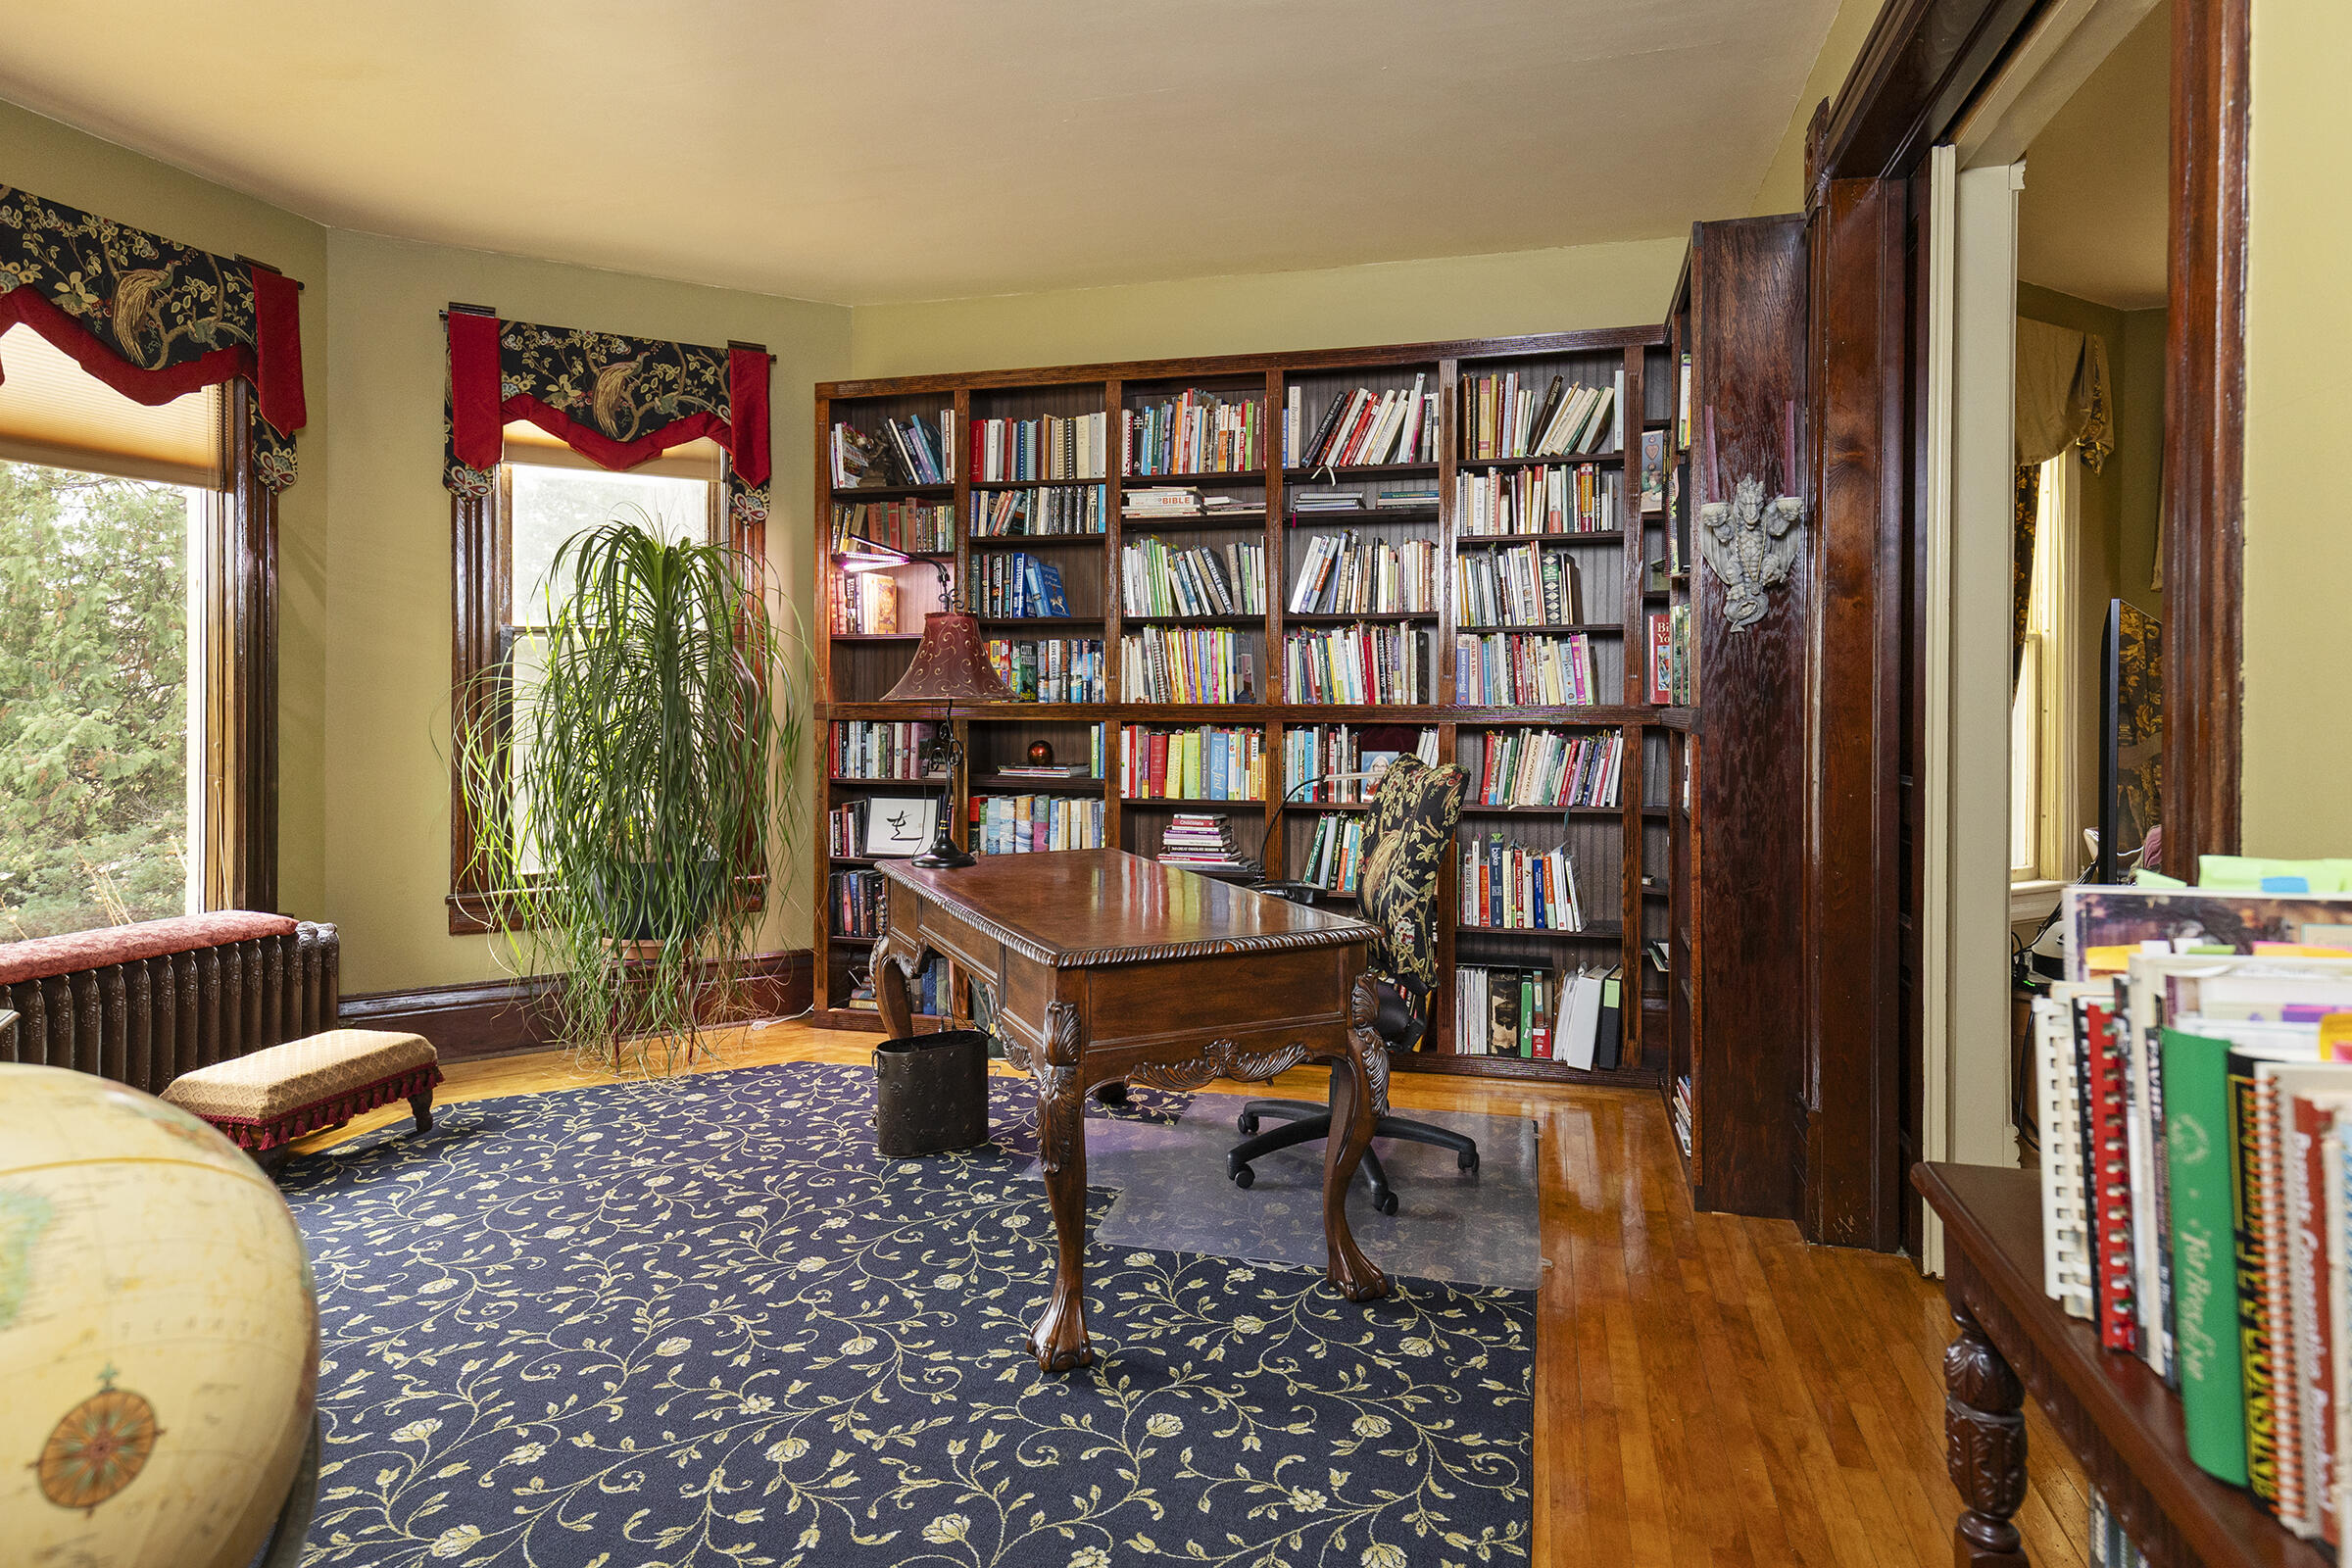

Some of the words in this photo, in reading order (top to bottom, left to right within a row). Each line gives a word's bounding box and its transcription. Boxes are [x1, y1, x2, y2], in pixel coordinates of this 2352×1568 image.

[1657, 621, 1670, 633] Bi
[1657, 633, 1670, 643] Yo
[1491, 847, 1500, 866] bake
